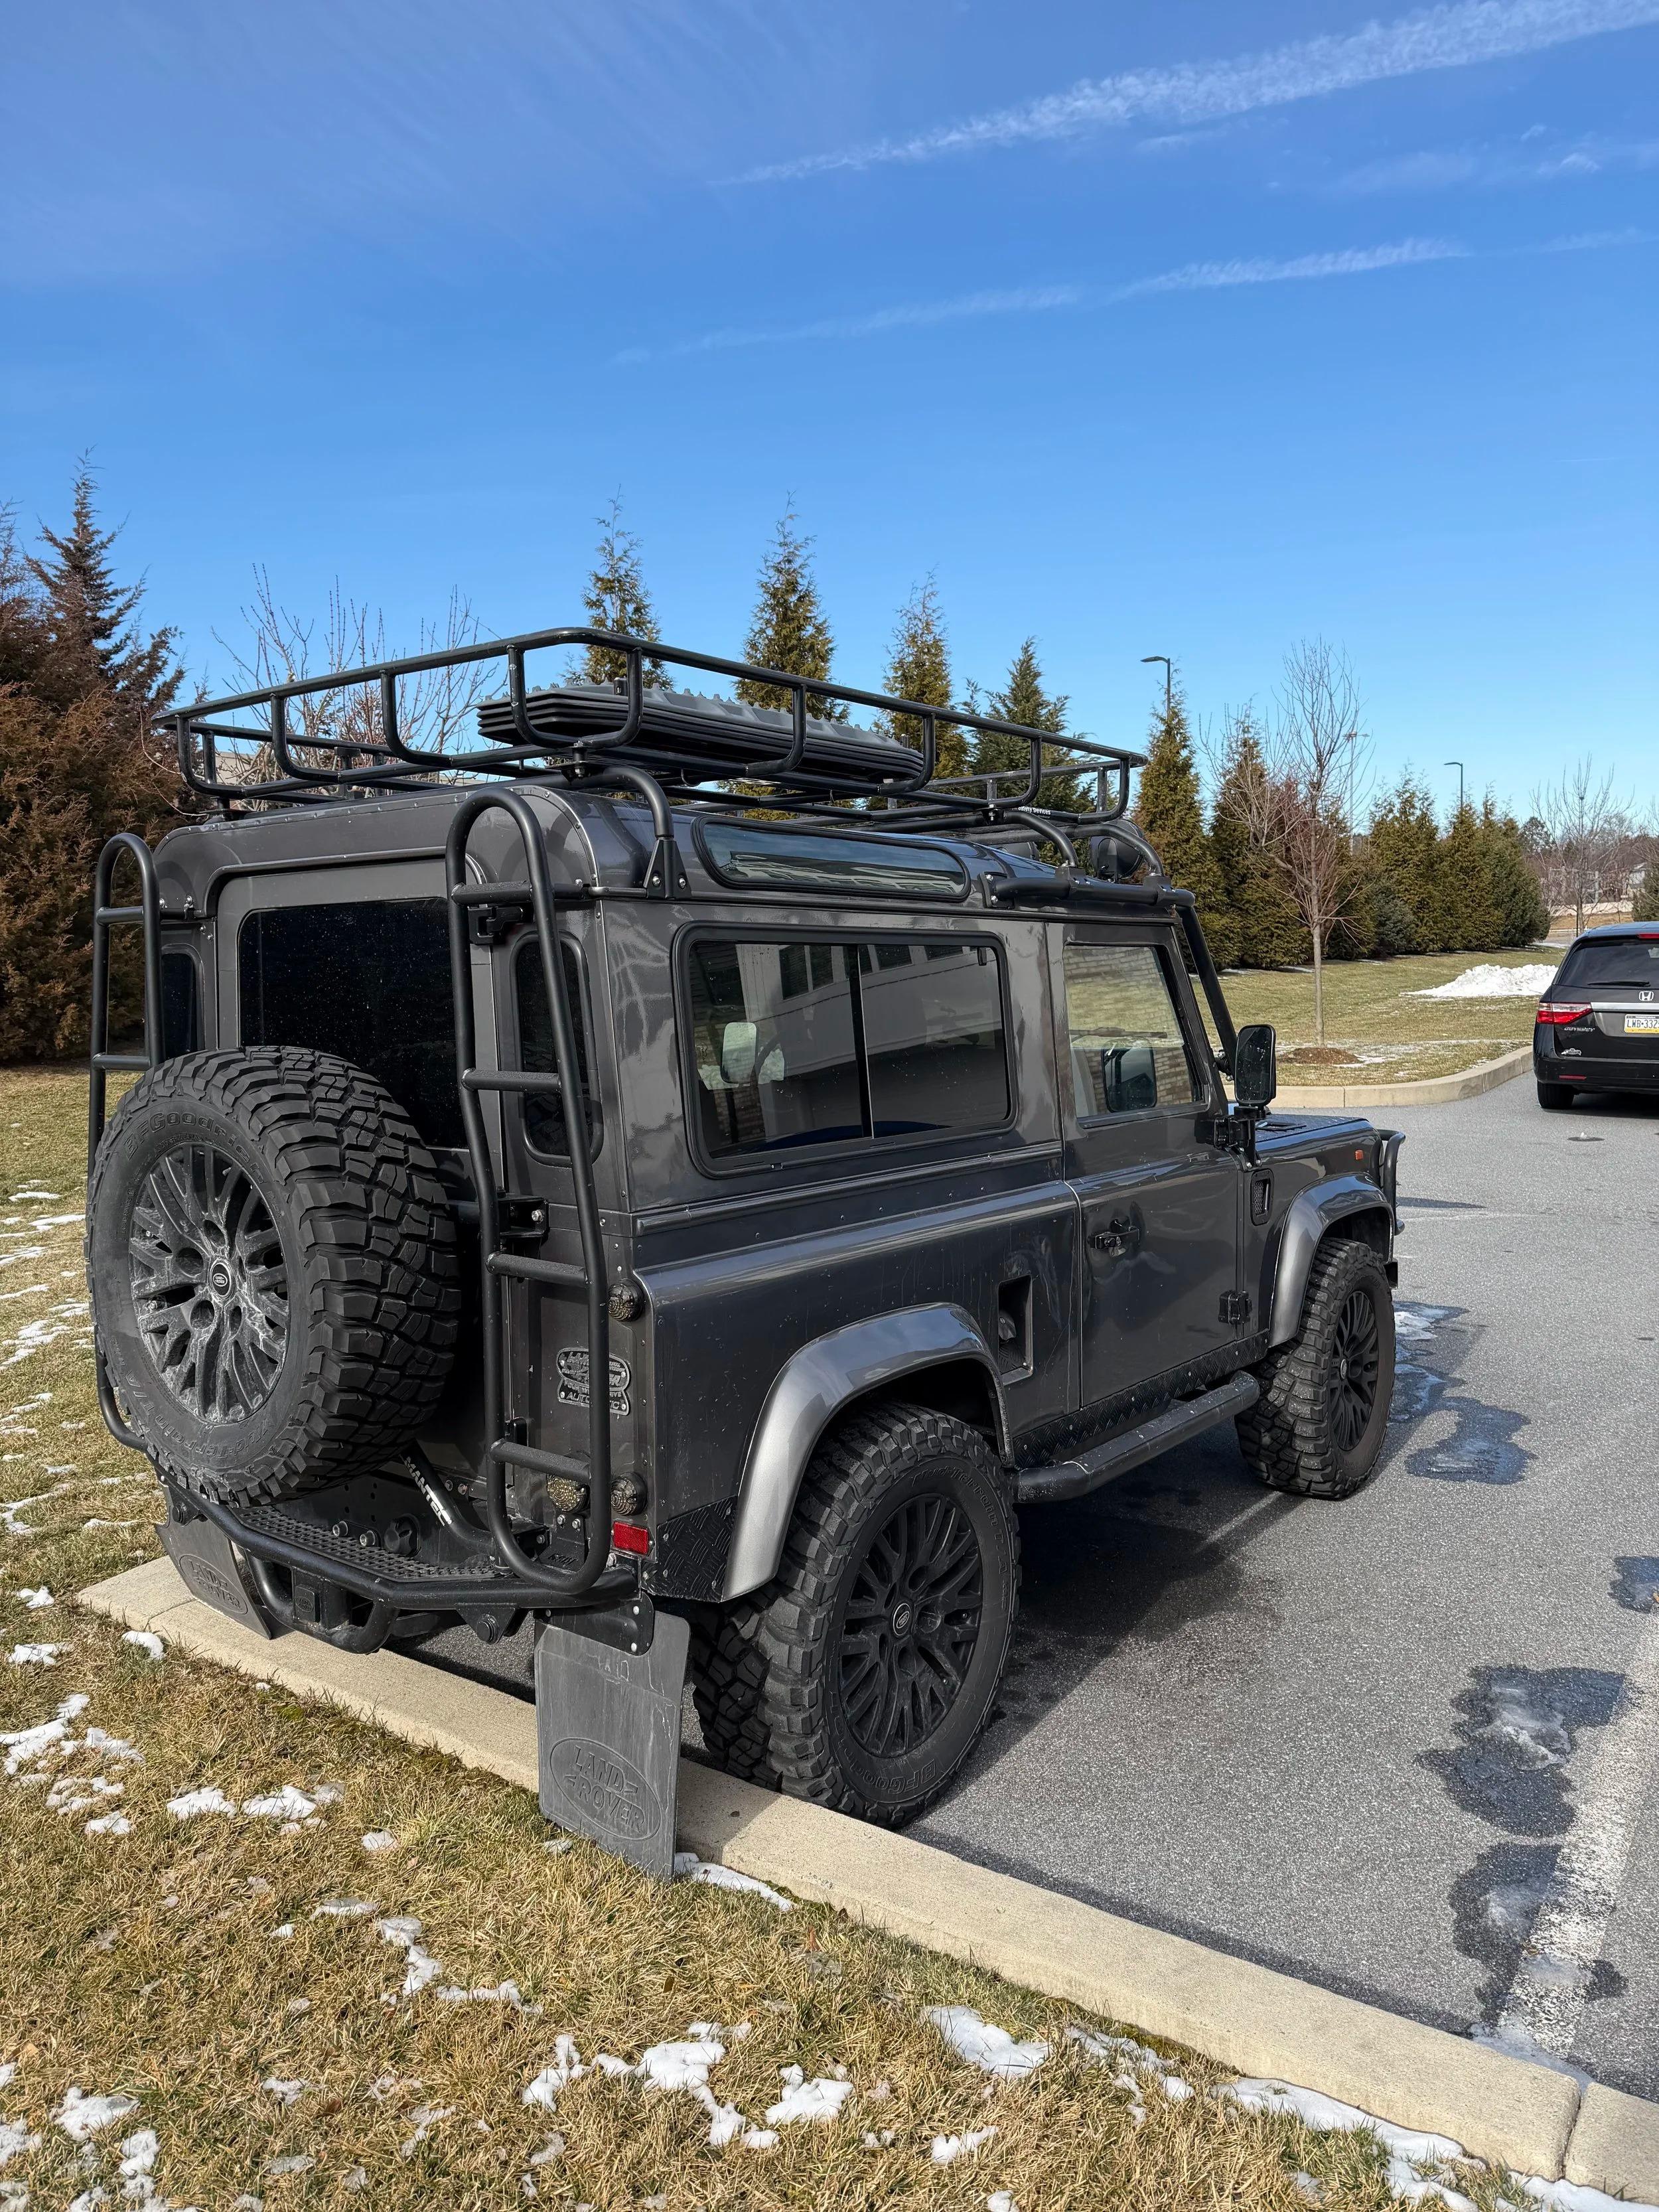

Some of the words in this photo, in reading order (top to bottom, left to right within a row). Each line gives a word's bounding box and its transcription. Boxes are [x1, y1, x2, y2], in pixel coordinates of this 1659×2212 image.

[1032, 806, 1051, 816] Devices
[123, 1112, 265, 1185] BFGoodrich
[398, 1454, 453, 1526] MANTEC
[575, 1745, 625, 1793] LAND
[576, 1775, 646, 1834] ROVER
